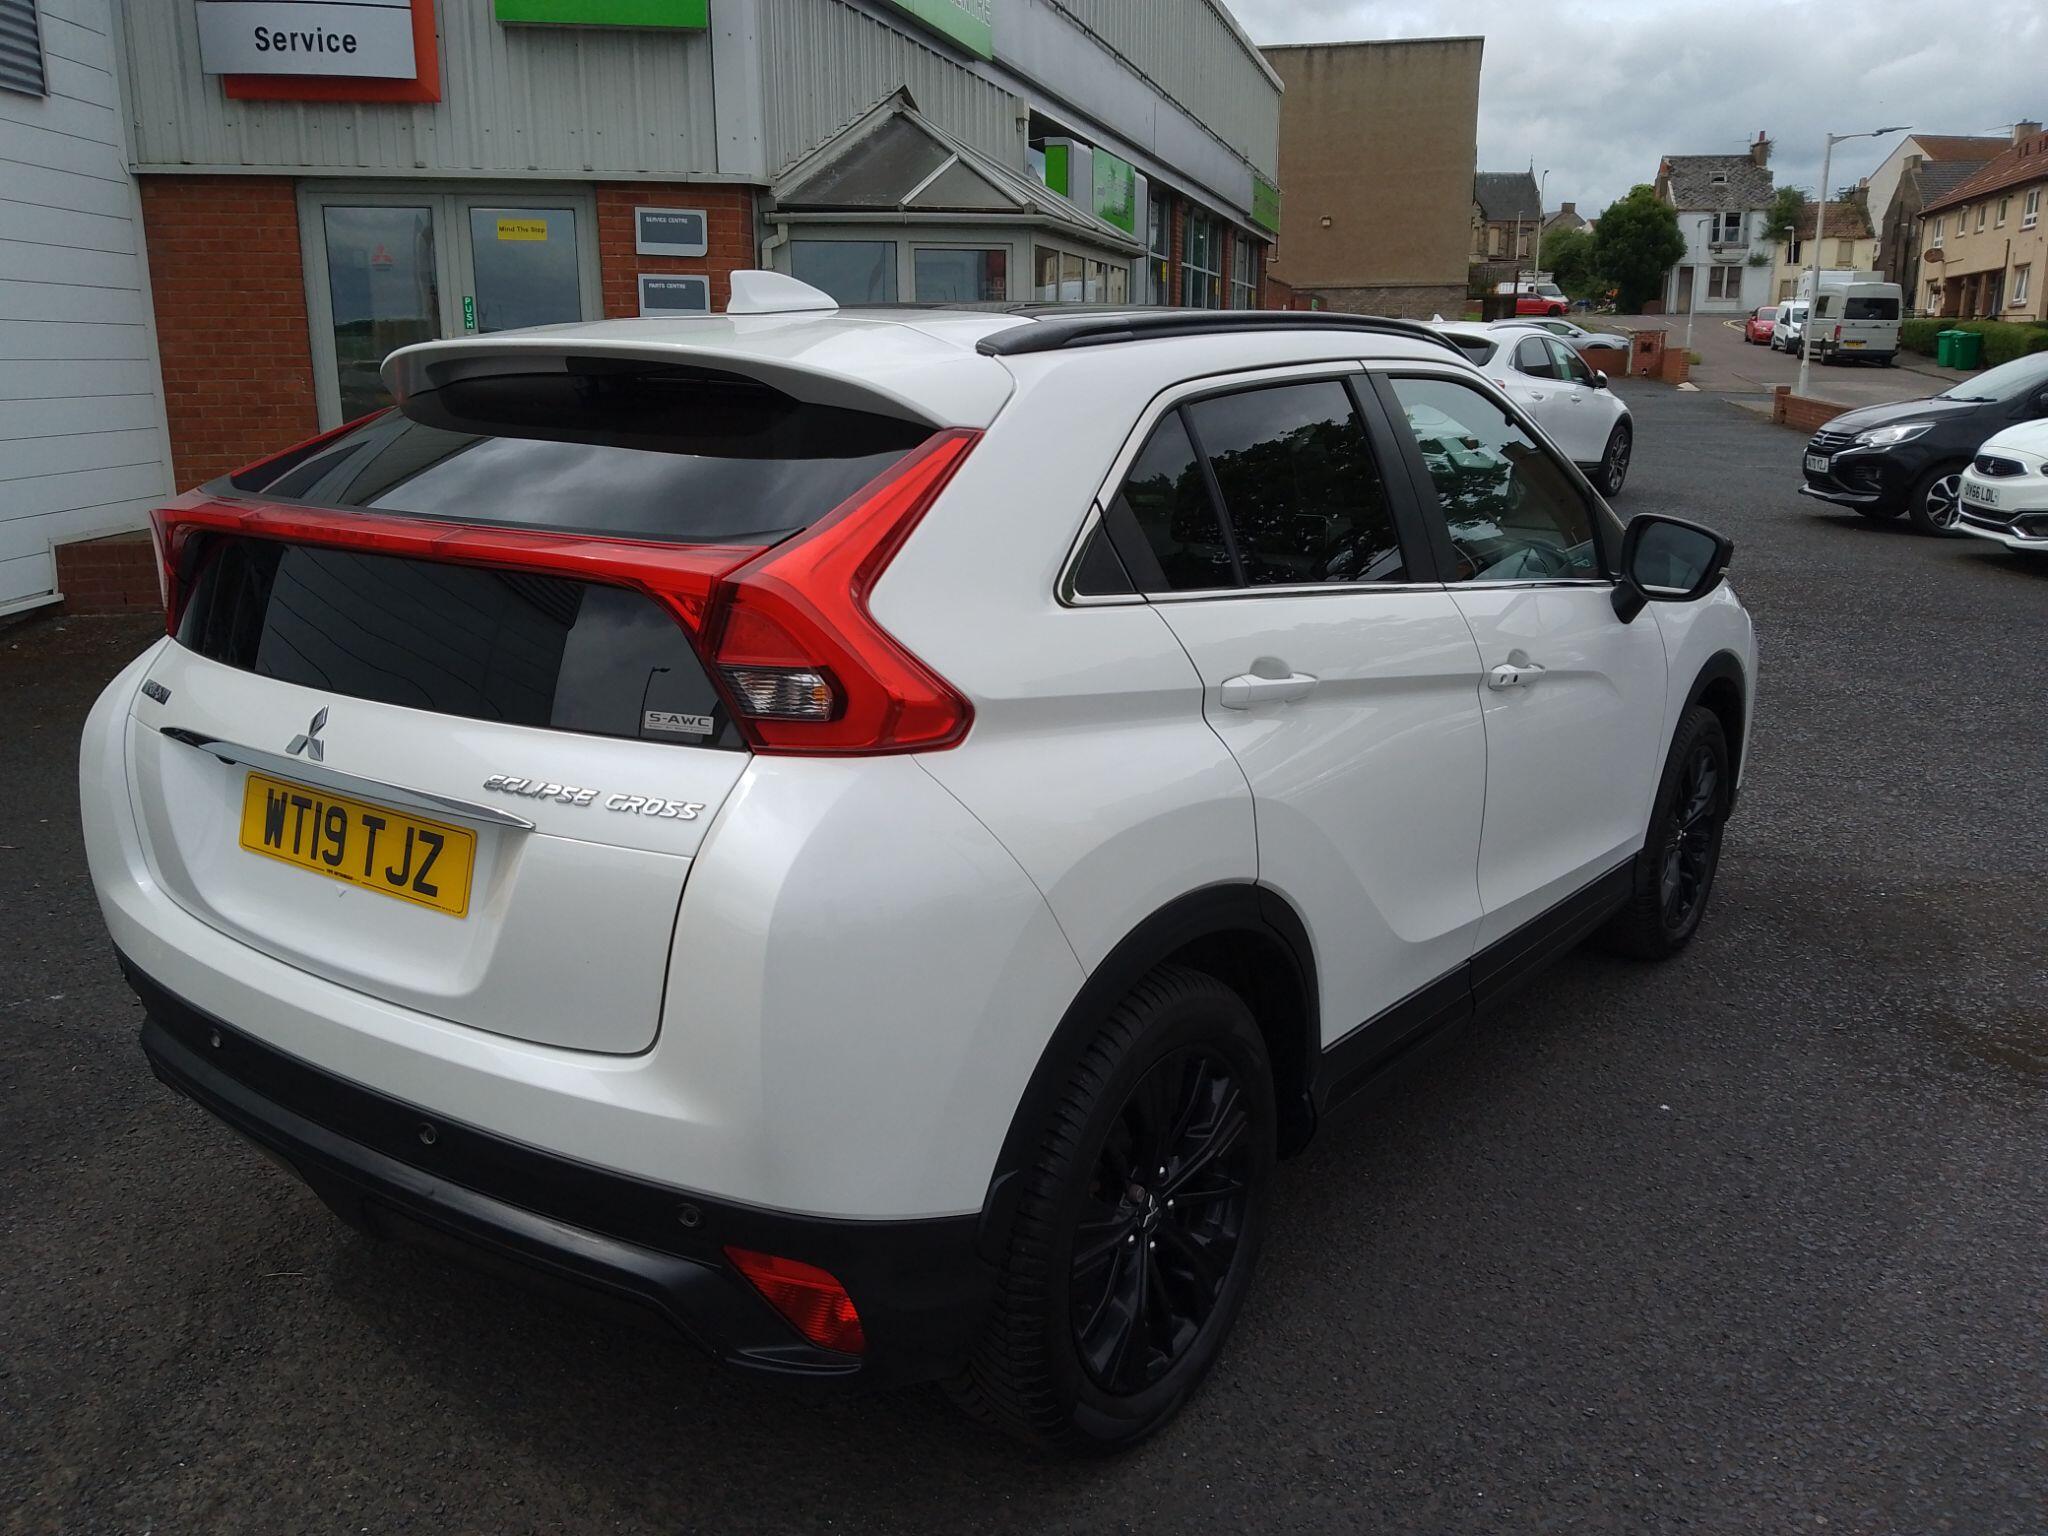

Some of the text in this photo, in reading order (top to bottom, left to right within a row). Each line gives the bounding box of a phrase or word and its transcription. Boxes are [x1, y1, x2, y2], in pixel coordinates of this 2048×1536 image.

[254, 26, 357, 54] Service
[498, 225, 515, 233] Mind
[516, 224, 529, 233] The
[645, 216, 688, 225] SERVICE CENTRE
[464, 297, 474, 329] PUSH
[1980, 486, 1996, 503] LDL
[648, 713, 711, 728] S-AWC
[483, 774, 705, 820] ECLIPSE CROSS
[264, 788, 445, 897] WT19 TJZ
